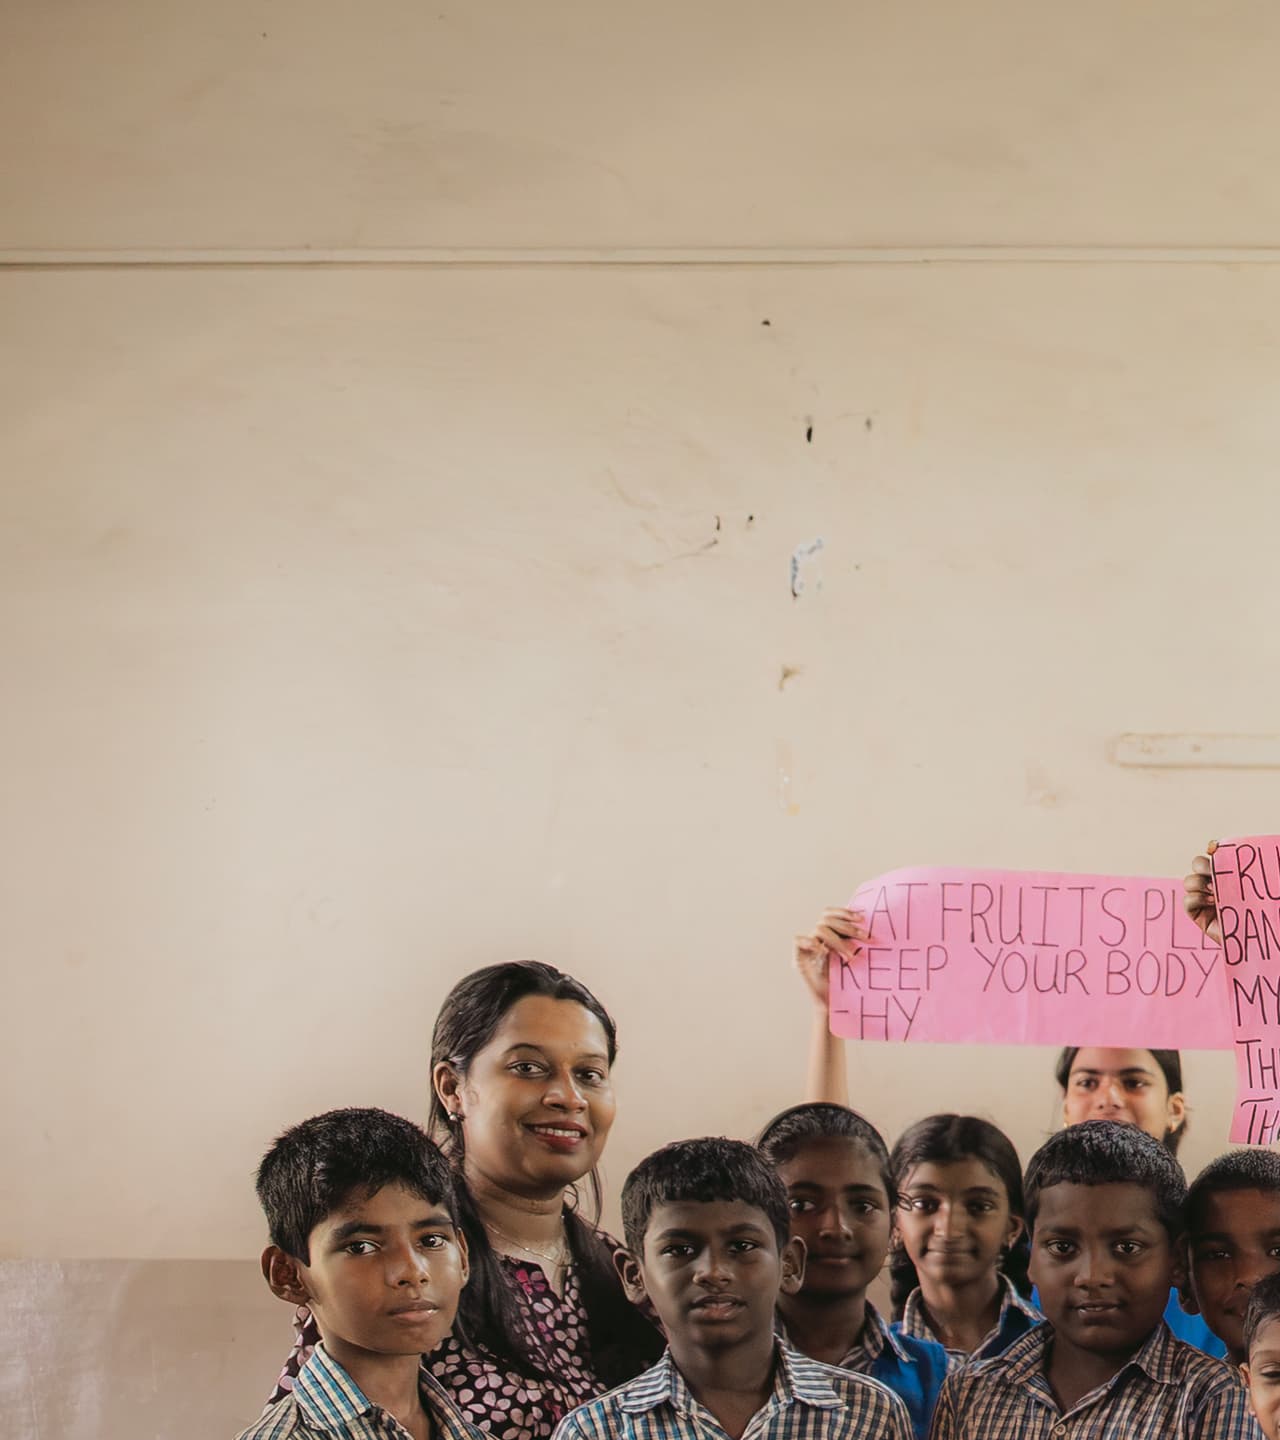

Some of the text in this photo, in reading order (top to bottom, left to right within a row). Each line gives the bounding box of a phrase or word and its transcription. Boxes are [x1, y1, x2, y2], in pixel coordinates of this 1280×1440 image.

[938, 882, 1127, 949] FRUITS
[838, 944, 1221, 999] KEEP YOUR BODY
